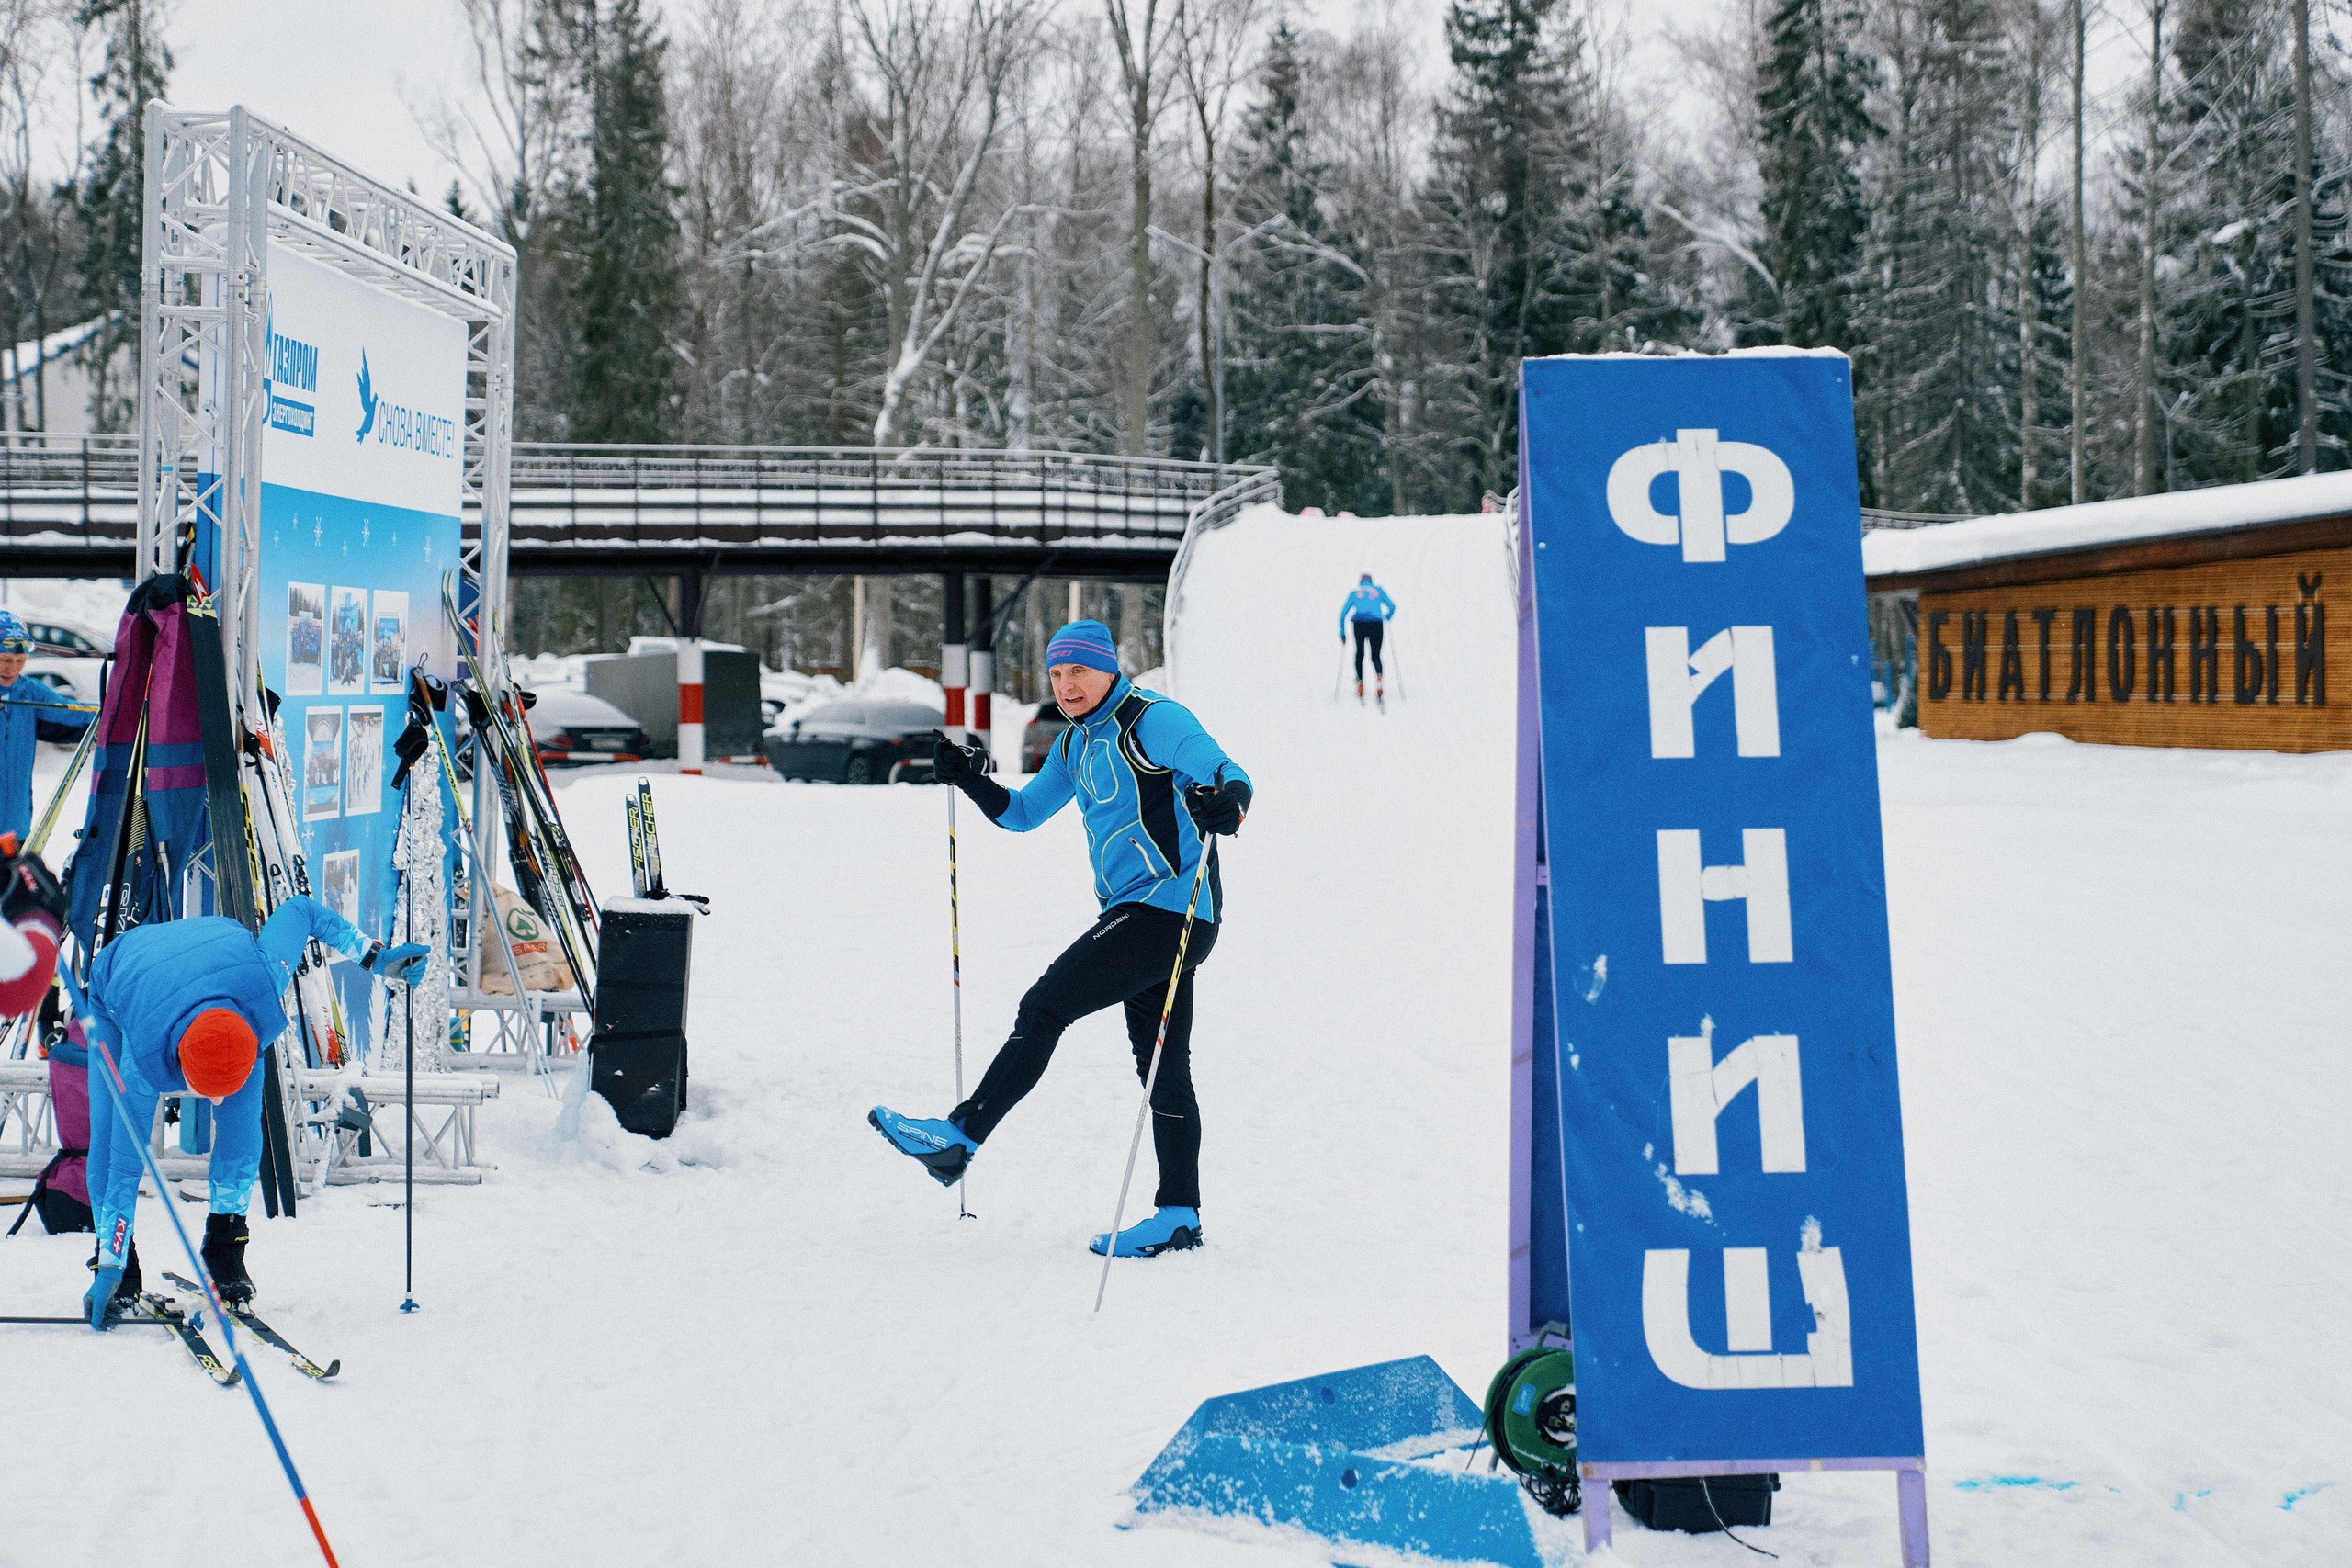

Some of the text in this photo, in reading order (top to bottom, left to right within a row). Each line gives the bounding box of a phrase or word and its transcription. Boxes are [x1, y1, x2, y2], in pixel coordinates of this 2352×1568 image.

[273, 333, 318, 393] ГАЗПРОМ
[378, 400, 455, 459] СНОВА ВМЕСТЕ!
[1928, 571, 2325, 706] БИАТЛОННЫЙ
[628, 807, 644, 870] FISCHER
[640, 792, 659, 859] FISCHER
[1092, 913, 1130, 941] NORDSKI
[1606, 428, 1853, 1390] ФИНИШ
[513, 942, 546, 954] SPAR
[896, 1122, 948, 1148] SPINE
